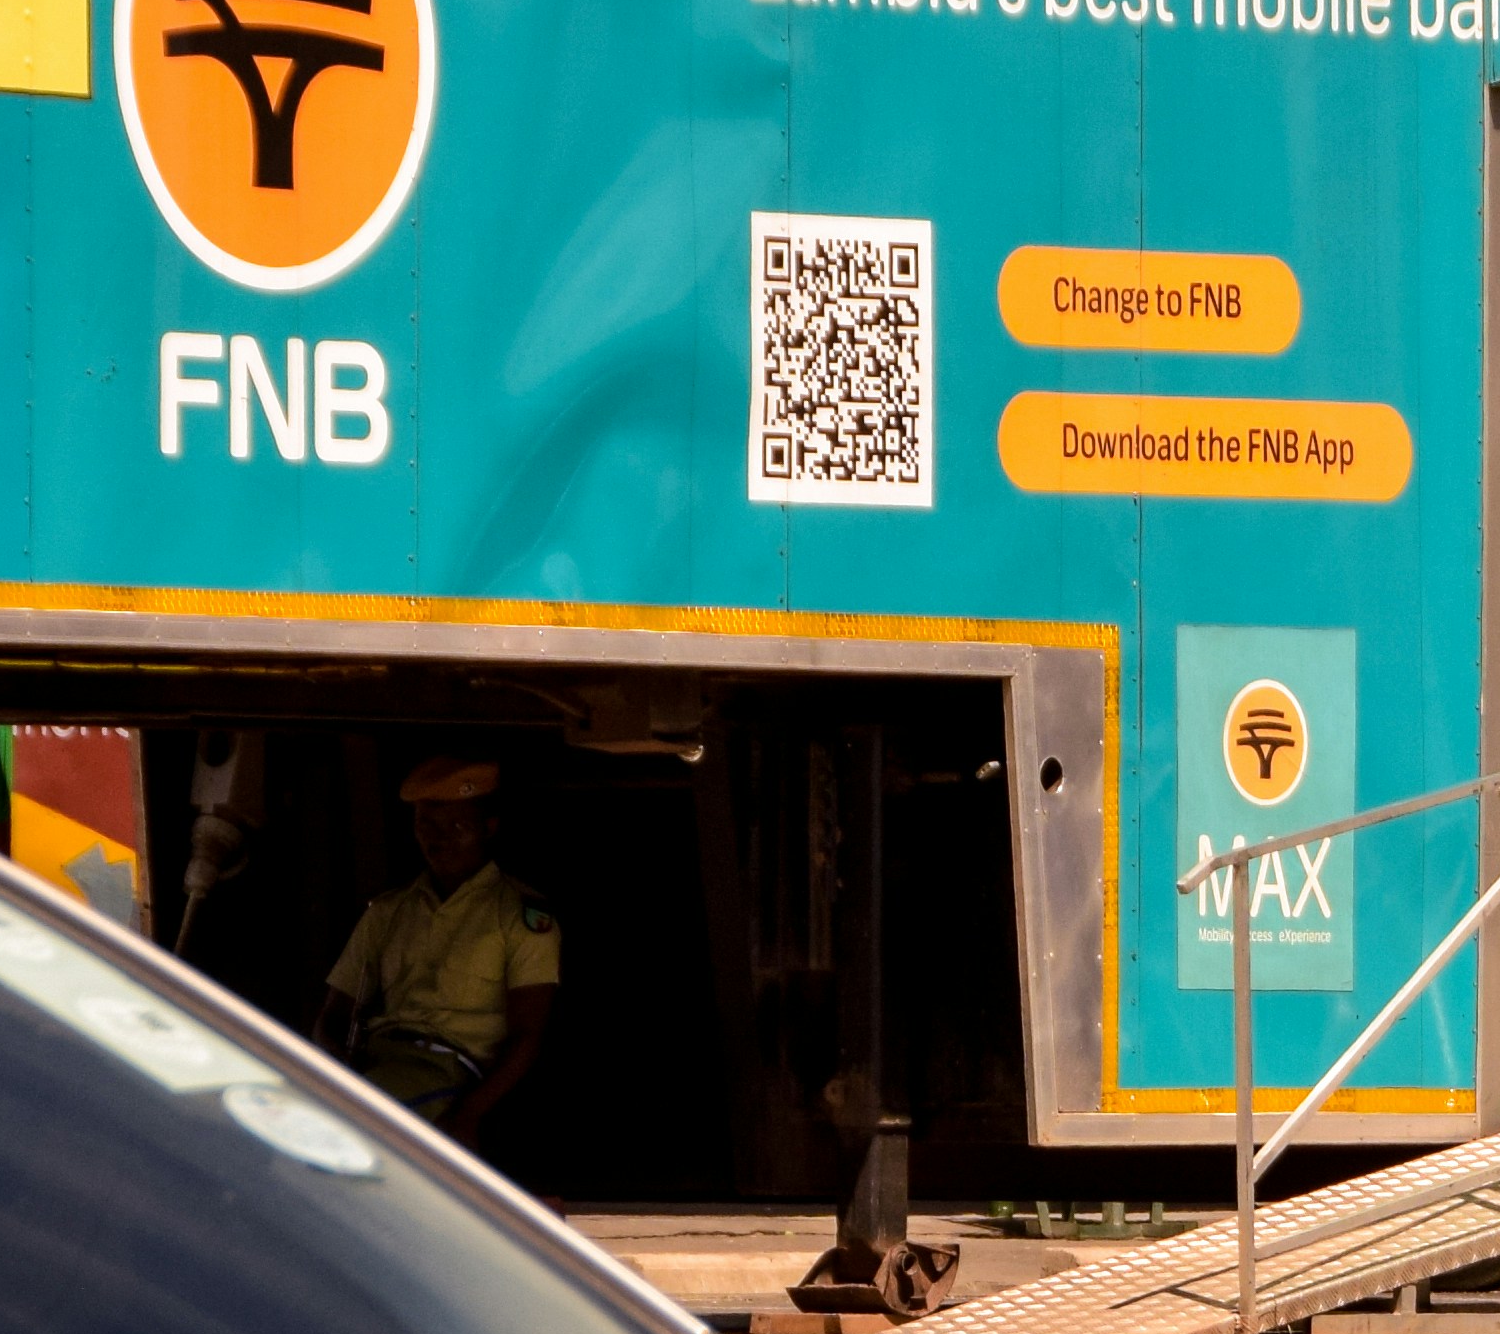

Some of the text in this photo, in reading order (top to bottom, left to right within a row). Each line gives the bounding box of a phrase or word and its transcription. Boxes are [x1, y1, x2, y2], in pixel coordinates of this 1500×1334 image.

[1053, 277, 1242, 324] Change to FNB
[159, 331, 392, 466] FNB
[1063, 423, 1354, 474] Download the FNB App
[1198, 834, 1332, 918] MAX
[1198, 927, 1332, 946] Mobility cess eXperience
